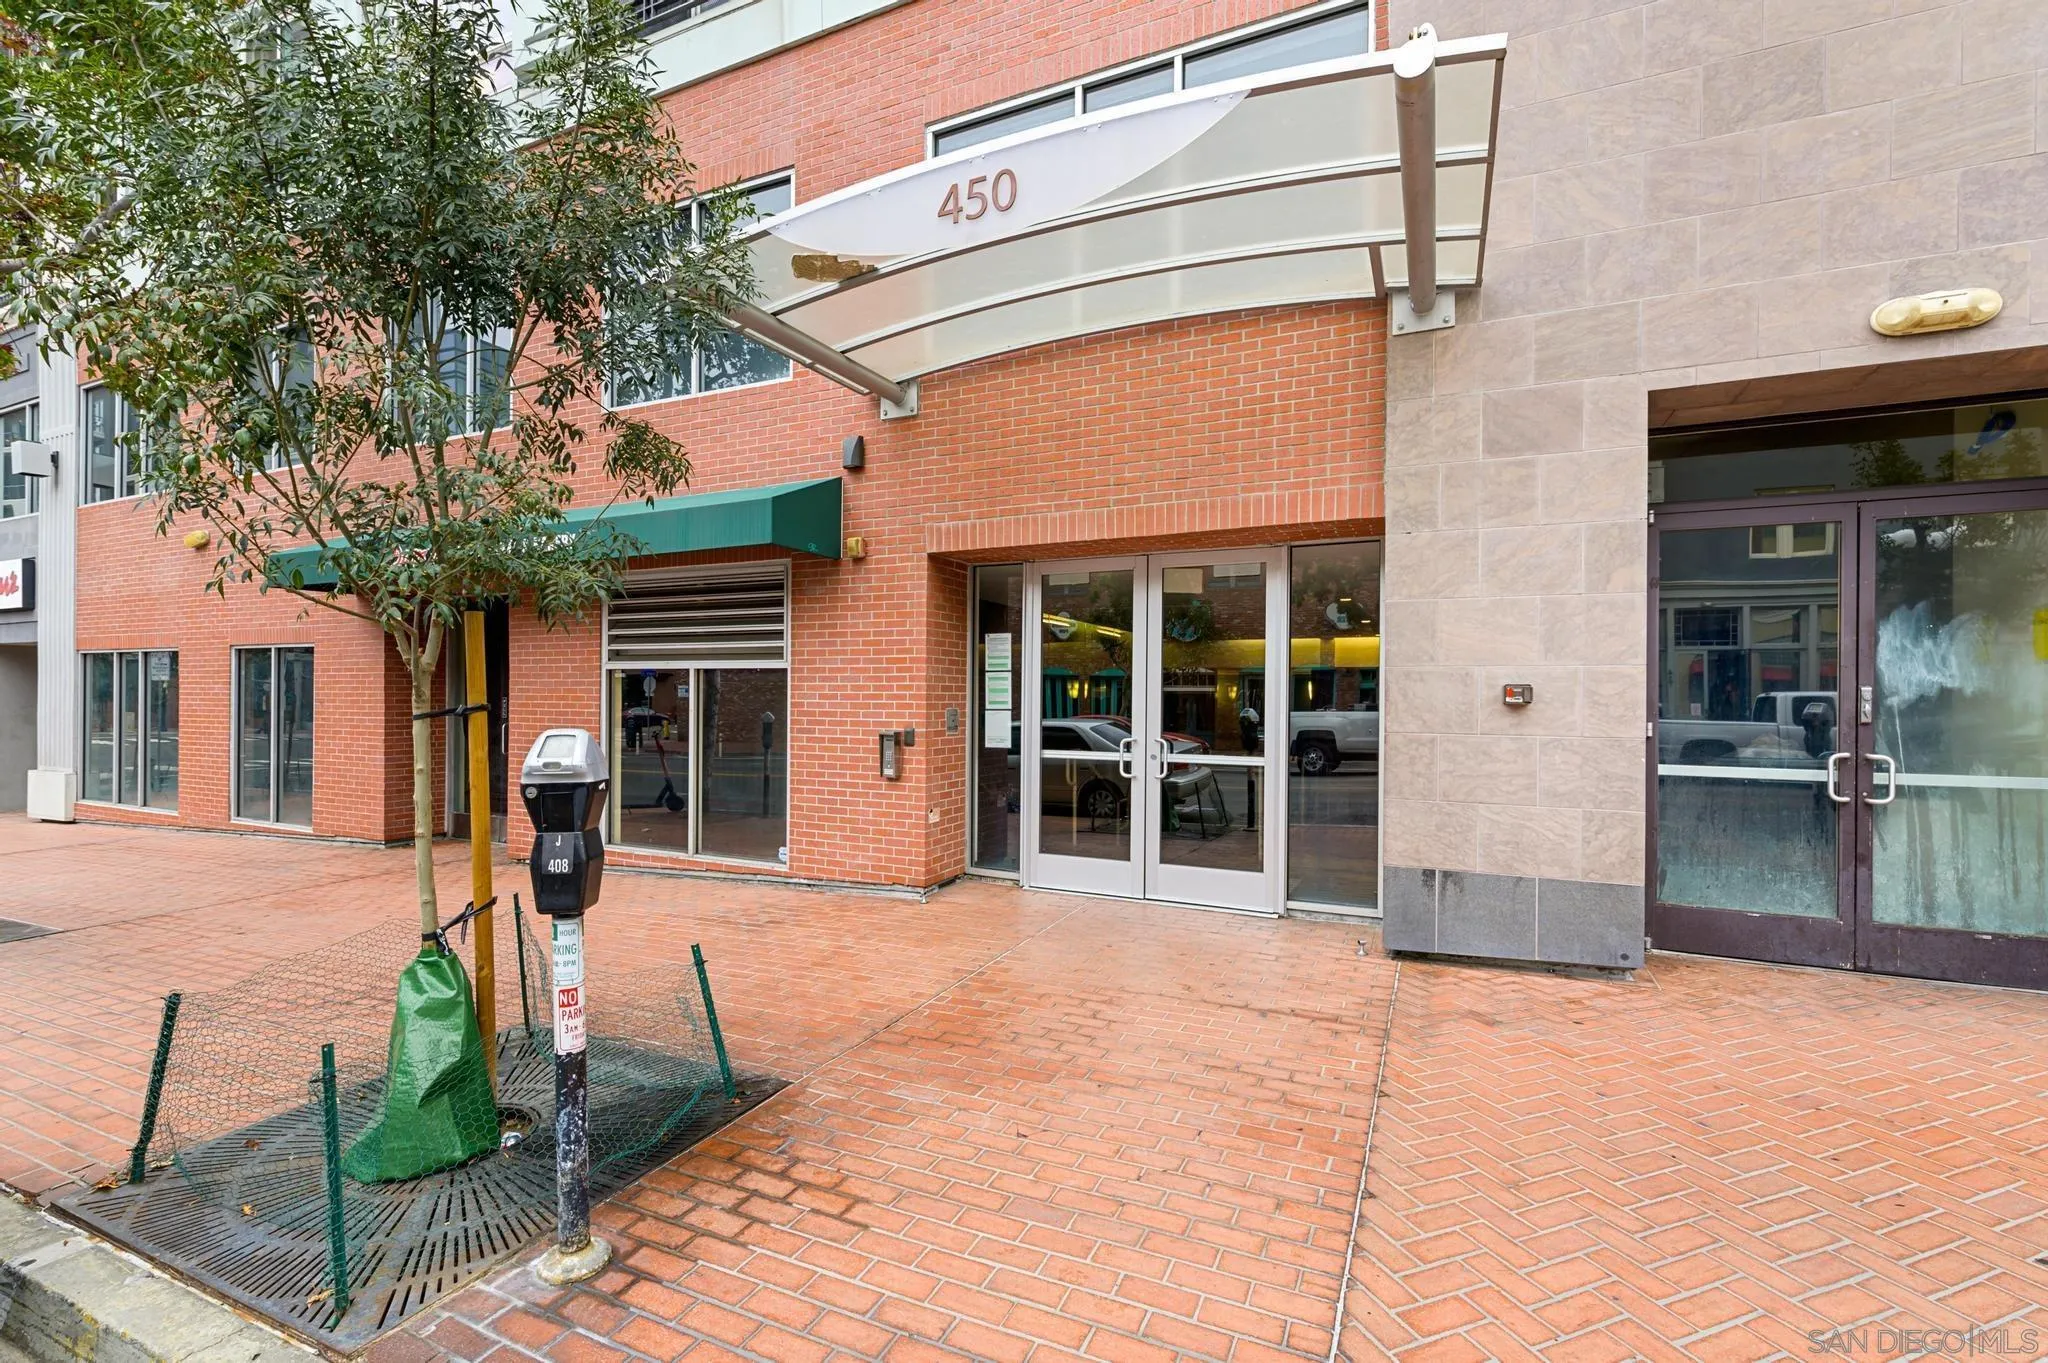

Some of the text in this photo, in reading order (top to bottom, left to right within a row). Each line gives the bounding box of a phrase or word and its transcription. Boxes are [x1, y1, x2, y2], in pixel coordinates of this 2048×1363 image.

[937, 168, 1017, 224] 450
[555, 834, 562, 846] J
[548, 858, 569, 873] 408
[559, 928, 577, 937] HOUR
[559, 989, 577, 1006] NO
